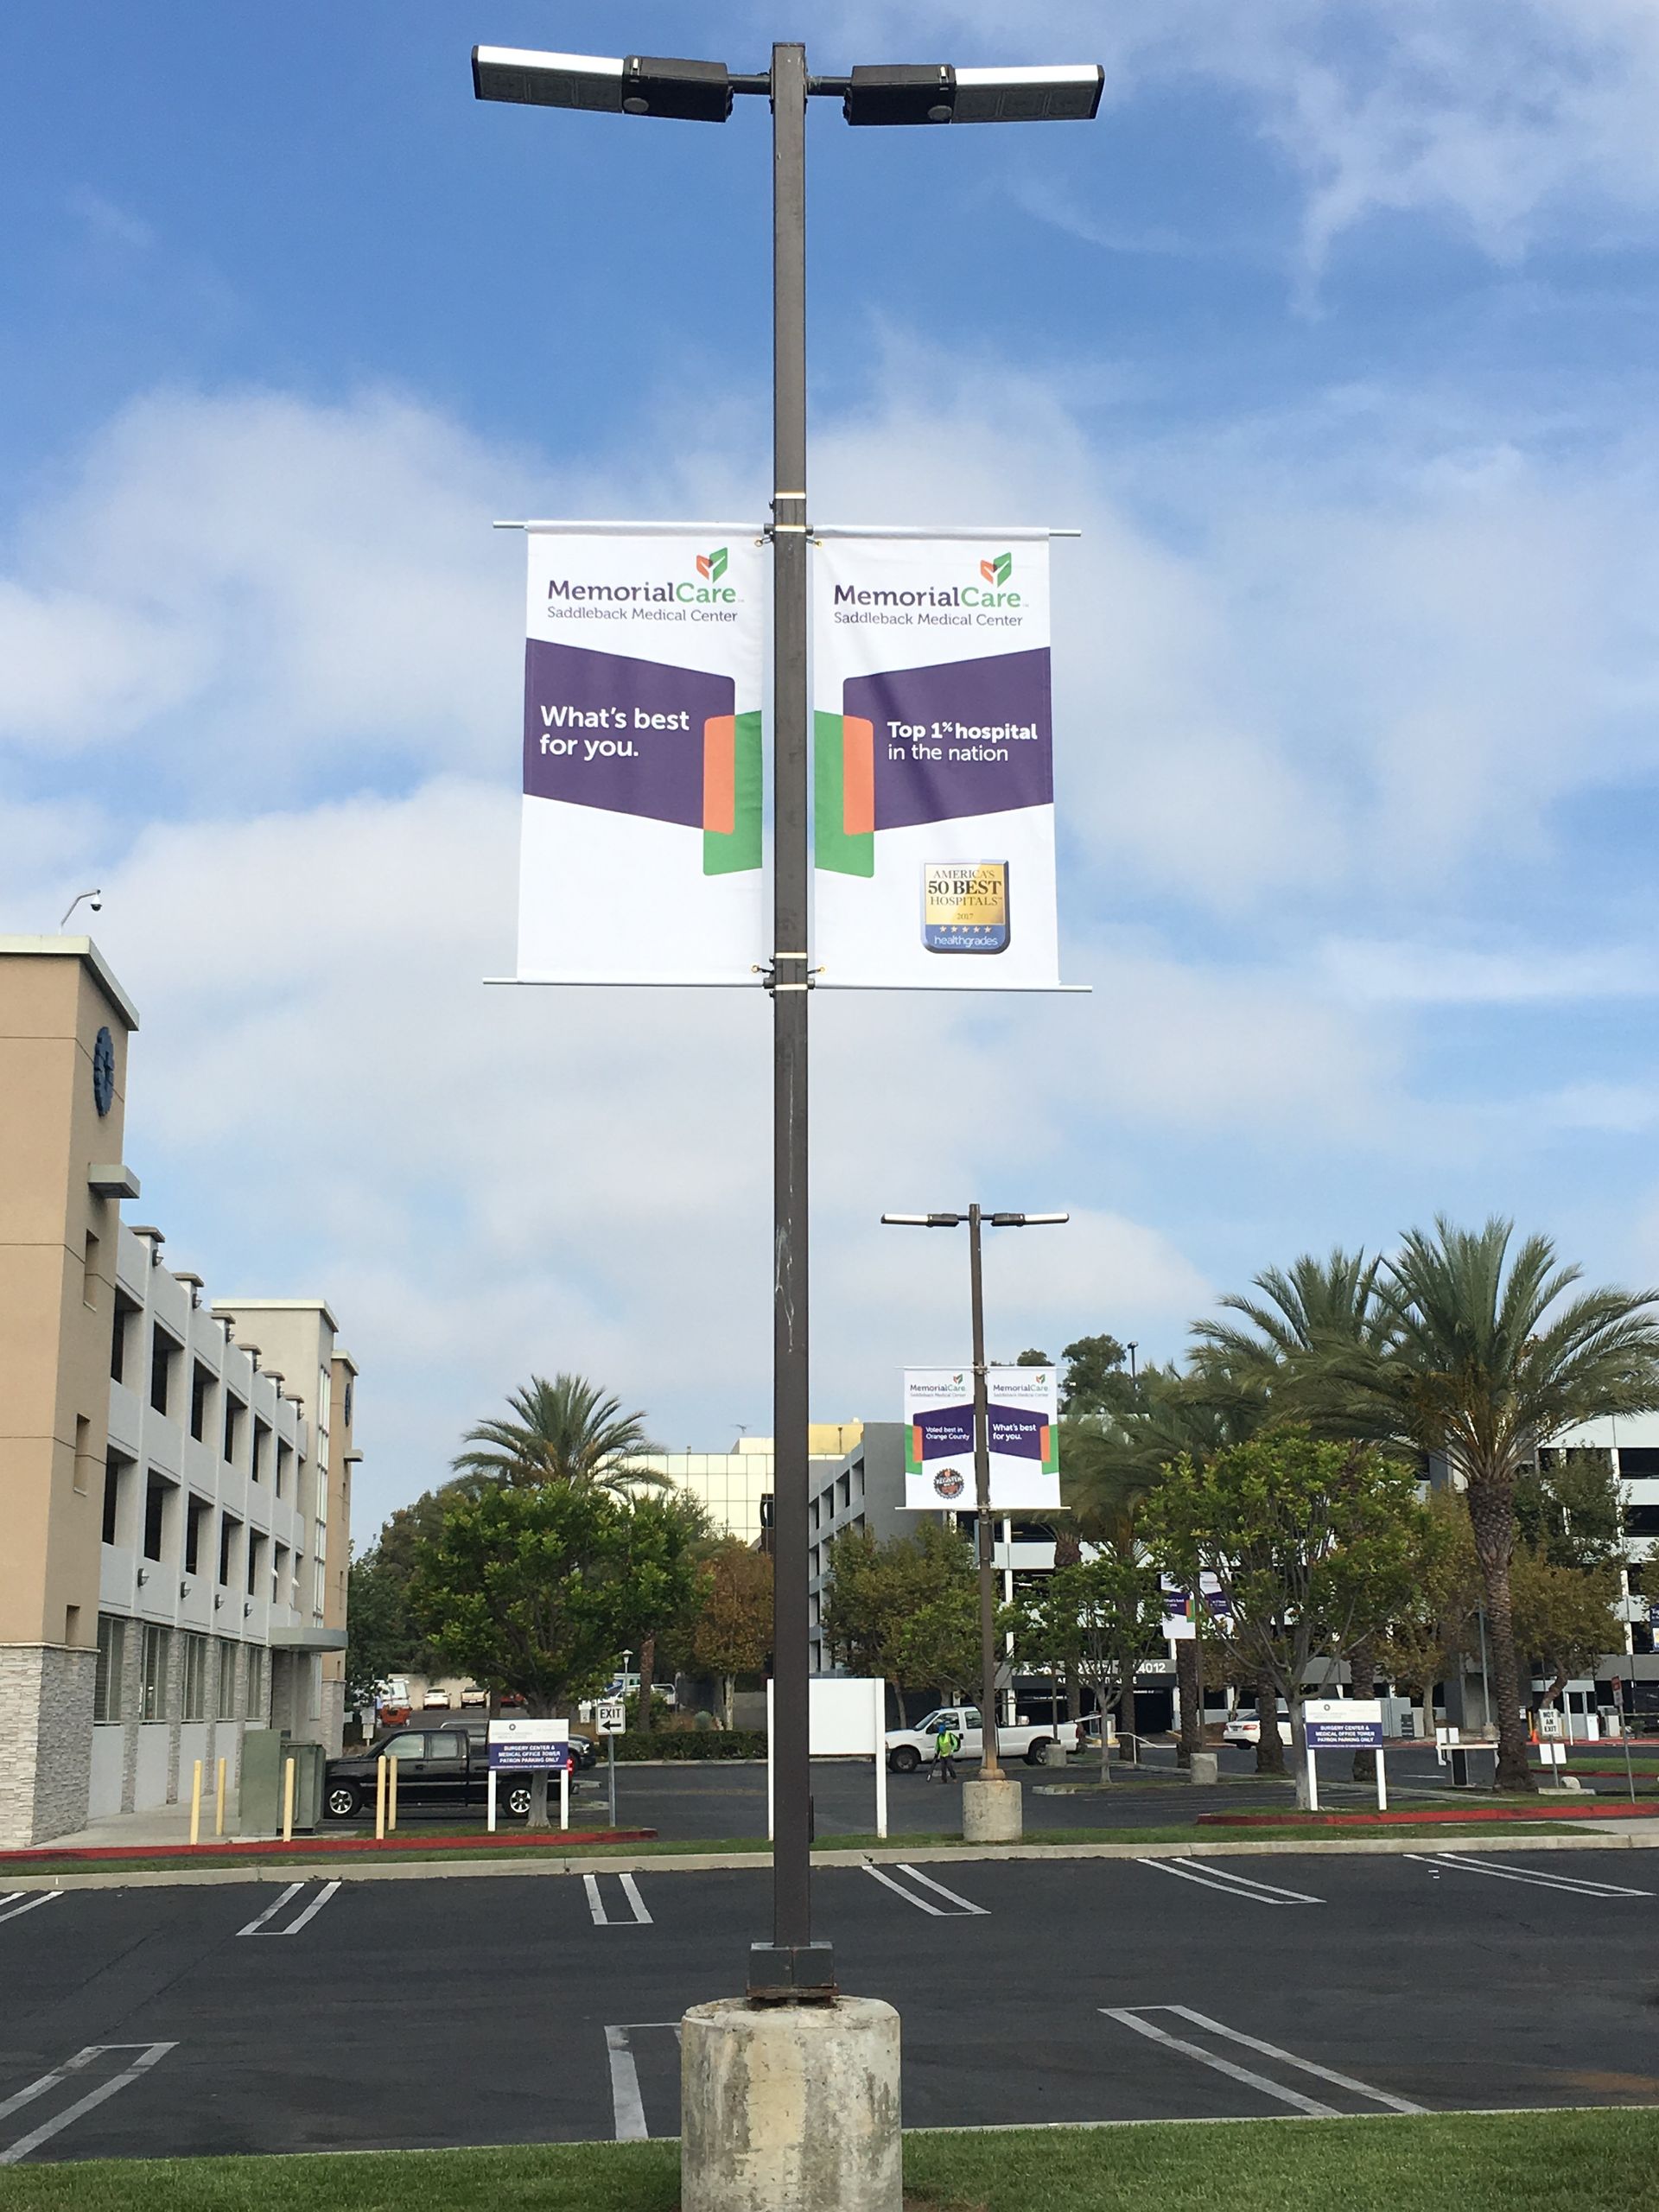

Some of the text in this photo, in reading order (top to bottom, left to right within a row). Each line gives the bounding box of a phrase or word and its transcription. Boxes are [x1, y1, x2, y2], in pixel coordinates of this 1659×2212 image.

[548, 580, 736, 603] MemorialCare
[834, 584, 1020, 607] MemorialCare
[547, 607, 738, 622] Saddleback Medical Center
[834, 612, 1023, 626] Saddleback Medical Center
[540, 705, 690, 731] What's best
[887, 721, 926, 741] Top
[540, 734, 639, 761] for you.
[887, 744, 1008, 762] in the nation
[933, 869, 995, 880] AMERICA'S
[928, 880, 1002, 895] 50 BEST
[930, 896, 998, 906] HOSPITALS
[934, 935, 998, 948] healthgrades
[993, 1423, 1037, 1432] What's best
[600, 1708, 621, 1719] EXIT
